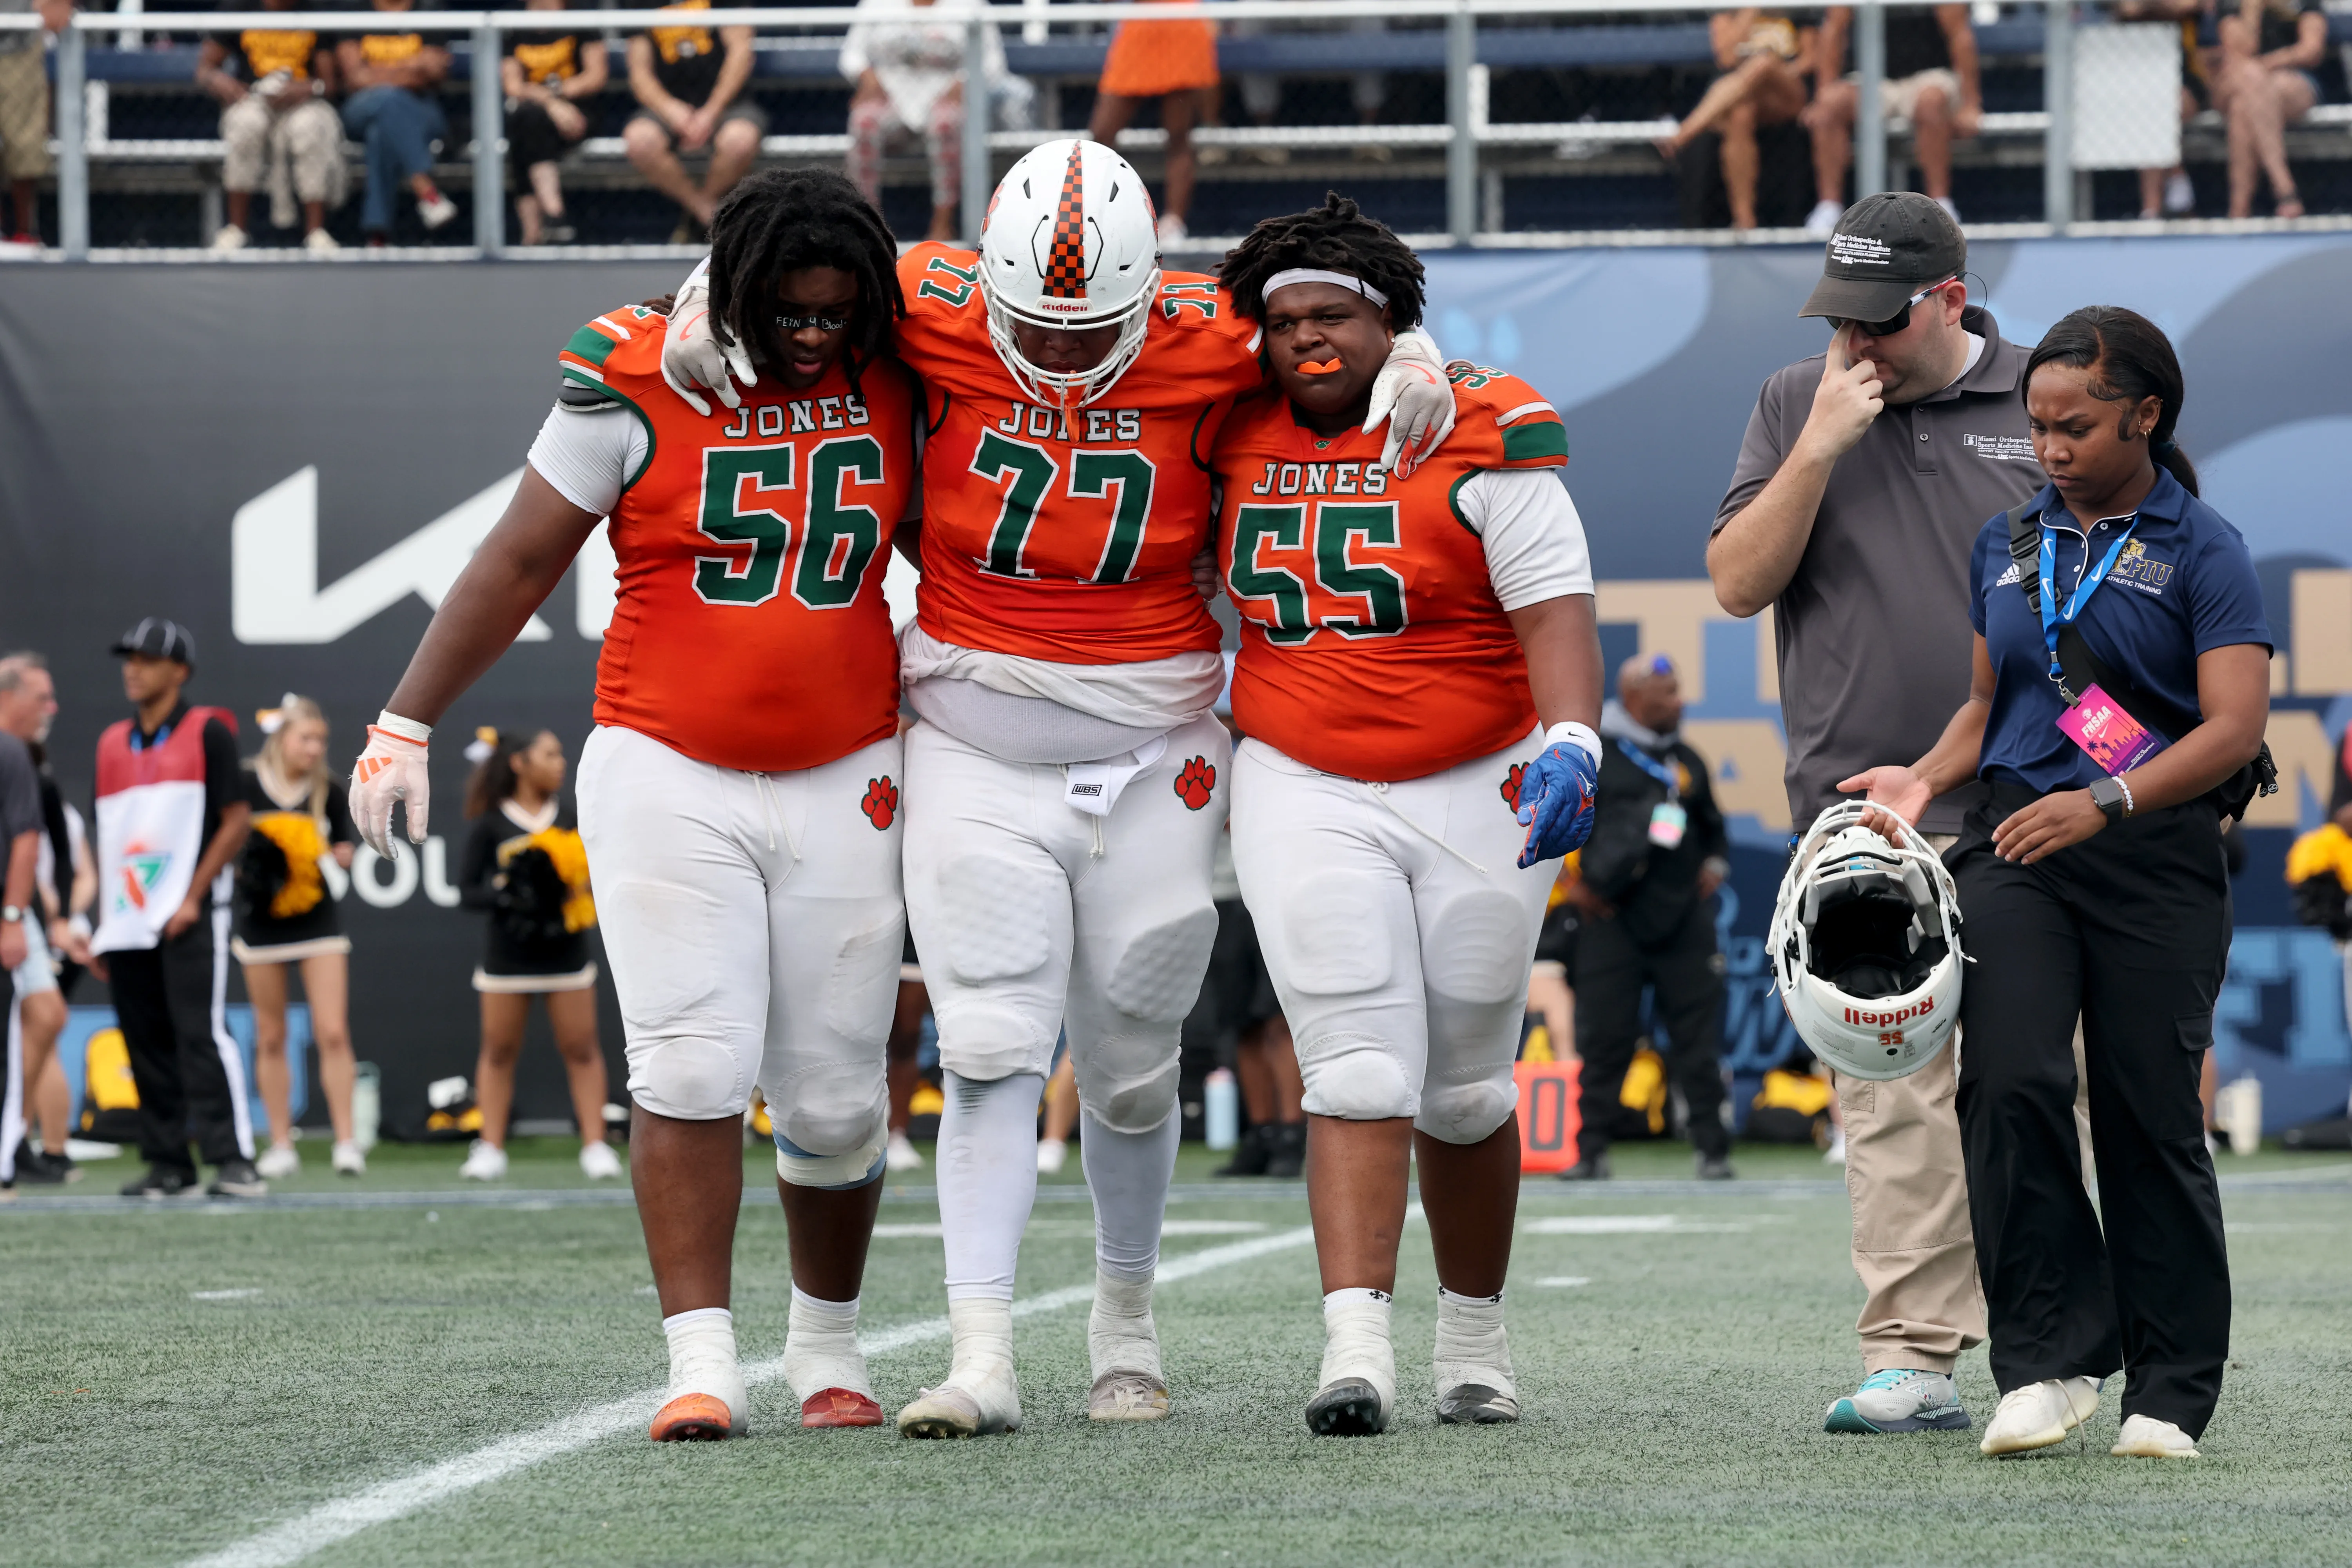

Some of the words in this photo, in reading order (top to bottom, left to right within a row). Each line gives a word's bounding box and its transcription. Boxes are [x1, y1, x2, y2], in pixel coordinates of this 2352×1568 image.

[1847, 235, 1876, 245] Orthopedics
[809, 317, 817, 326] 4
[722, 394, 870, 439] JONES
[1252, 462, 1388, 495] JONES
[968, 425, 1157, 584] 77
[692, 433, 887, 611] 56
[1227, 500, 1409, 647] 55
[1996, 574, 2020, 586] adida
[2106, 575, 2134, 586] ATHLETIC
[2134, 582, 2161, 595] TRAINING
[2125, 558, 2173, 586] FIU
[2081, 705, 2112, 738] FHSAA
[2131, 752, 2141, 763] FOLLOW
[1074, 785, 1099, 793] WBS
[1845, 996, 1934, 1027] Riddell
[1880, 1031, 1903, 1045] 55
